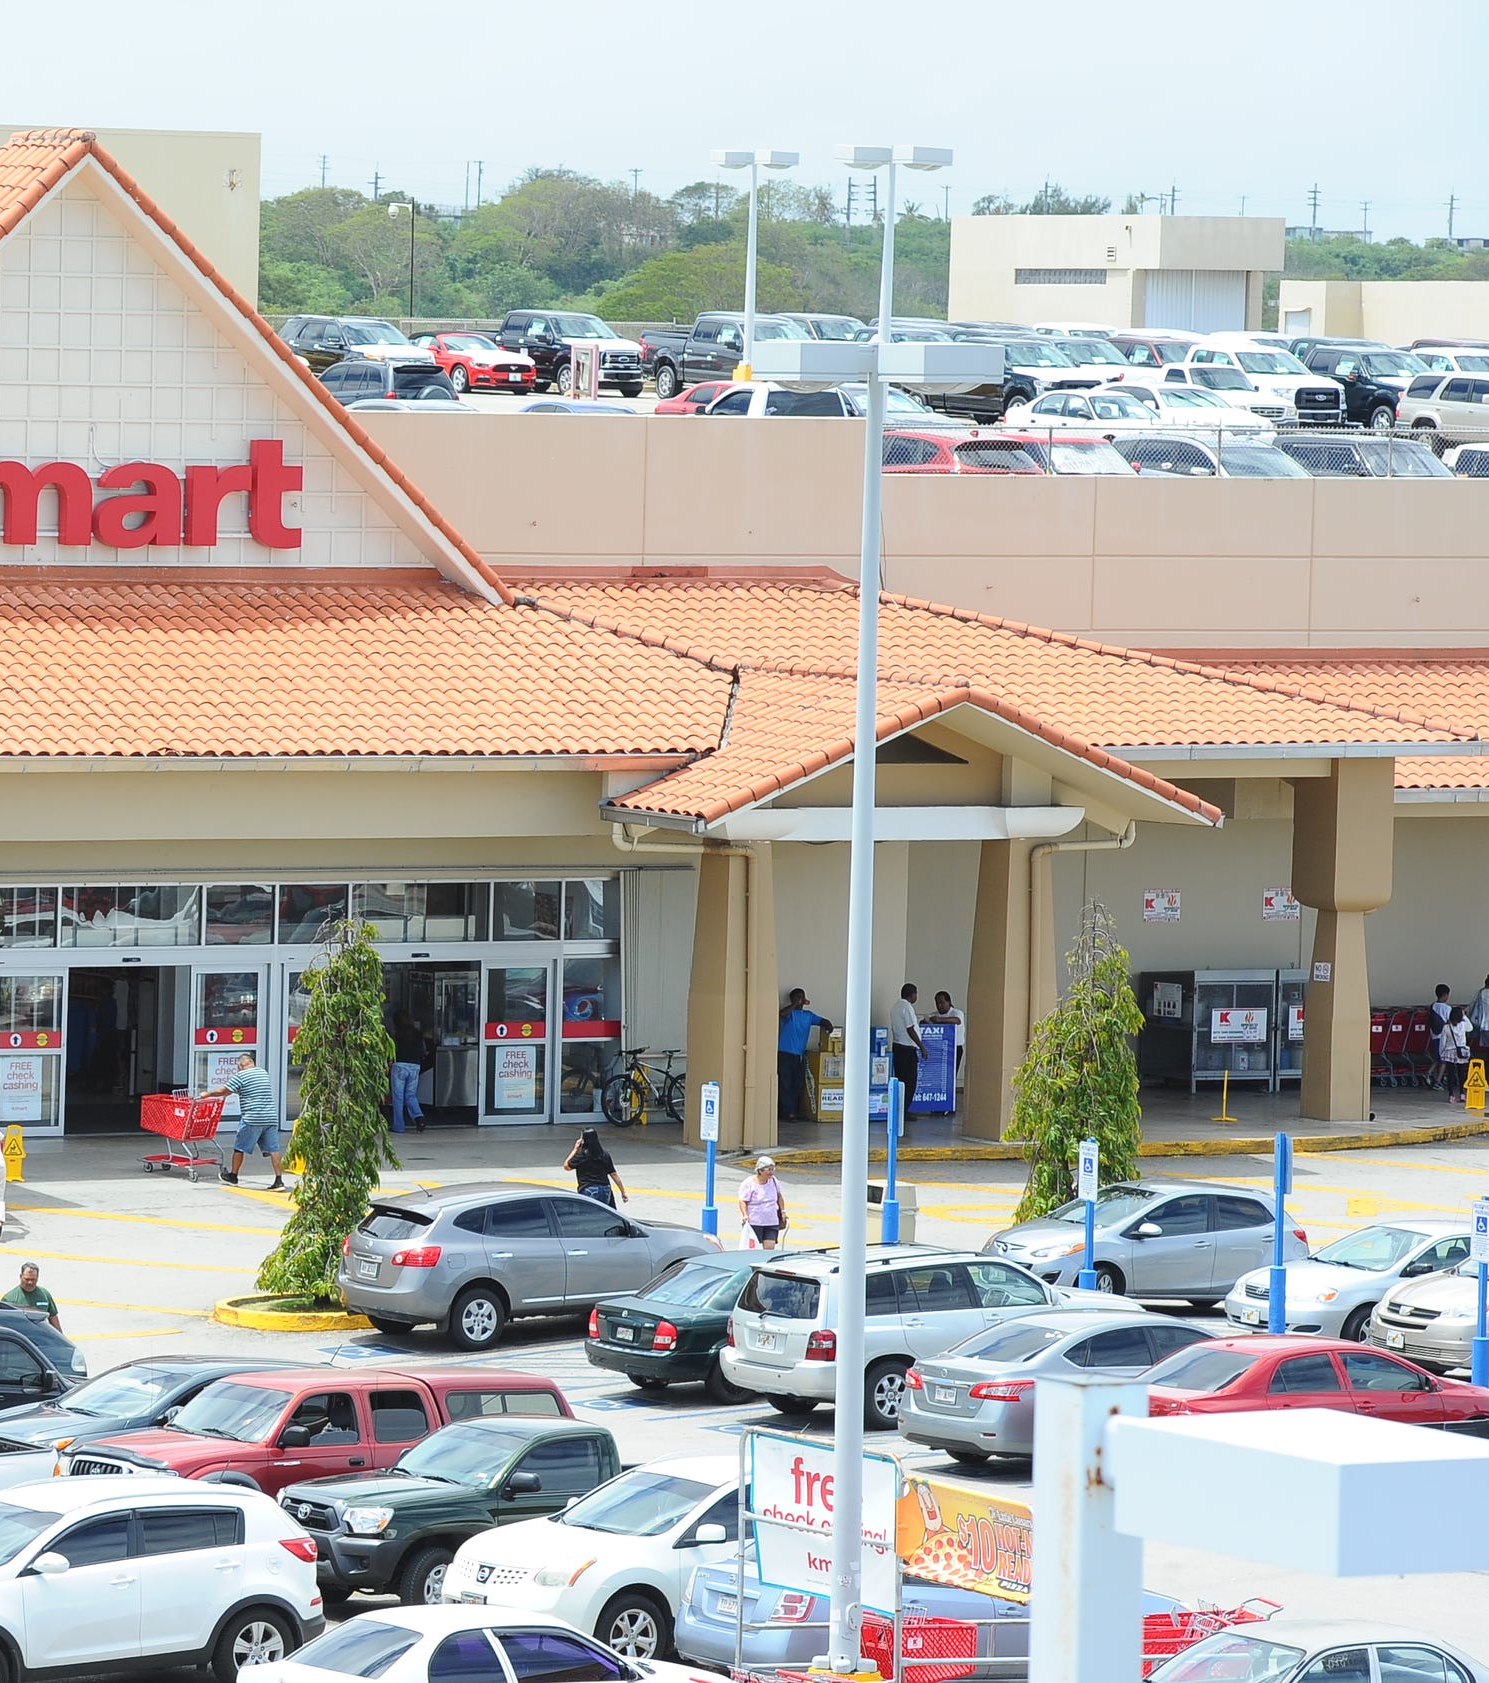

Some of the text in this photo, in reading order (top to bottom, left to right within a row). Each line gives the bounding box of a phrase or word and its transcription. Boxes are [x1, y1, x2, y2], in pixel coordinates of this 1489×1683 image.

[920, 1026, 944, 1034] TAXI
[505, 1050, 527, 1059] FREE
[10, 1061, 32, 1070] FREE
[503, 1060, 530, 1069] check
[7, 1071, 35, 1080] check
[215, 1067, 240, 1076] chec
[499, 1069, 532, 1080] cashing
[3, 1081, 39, 1091] cashing
[922, 1092, 947, 1102] 647-1244
[790, 1457, 834, 1512] fre
[957, 1513, 996, 1574] $10
[997, 1550, 1032, 1585] READ
[999, 1580, 1030, 1594] PIZZA
